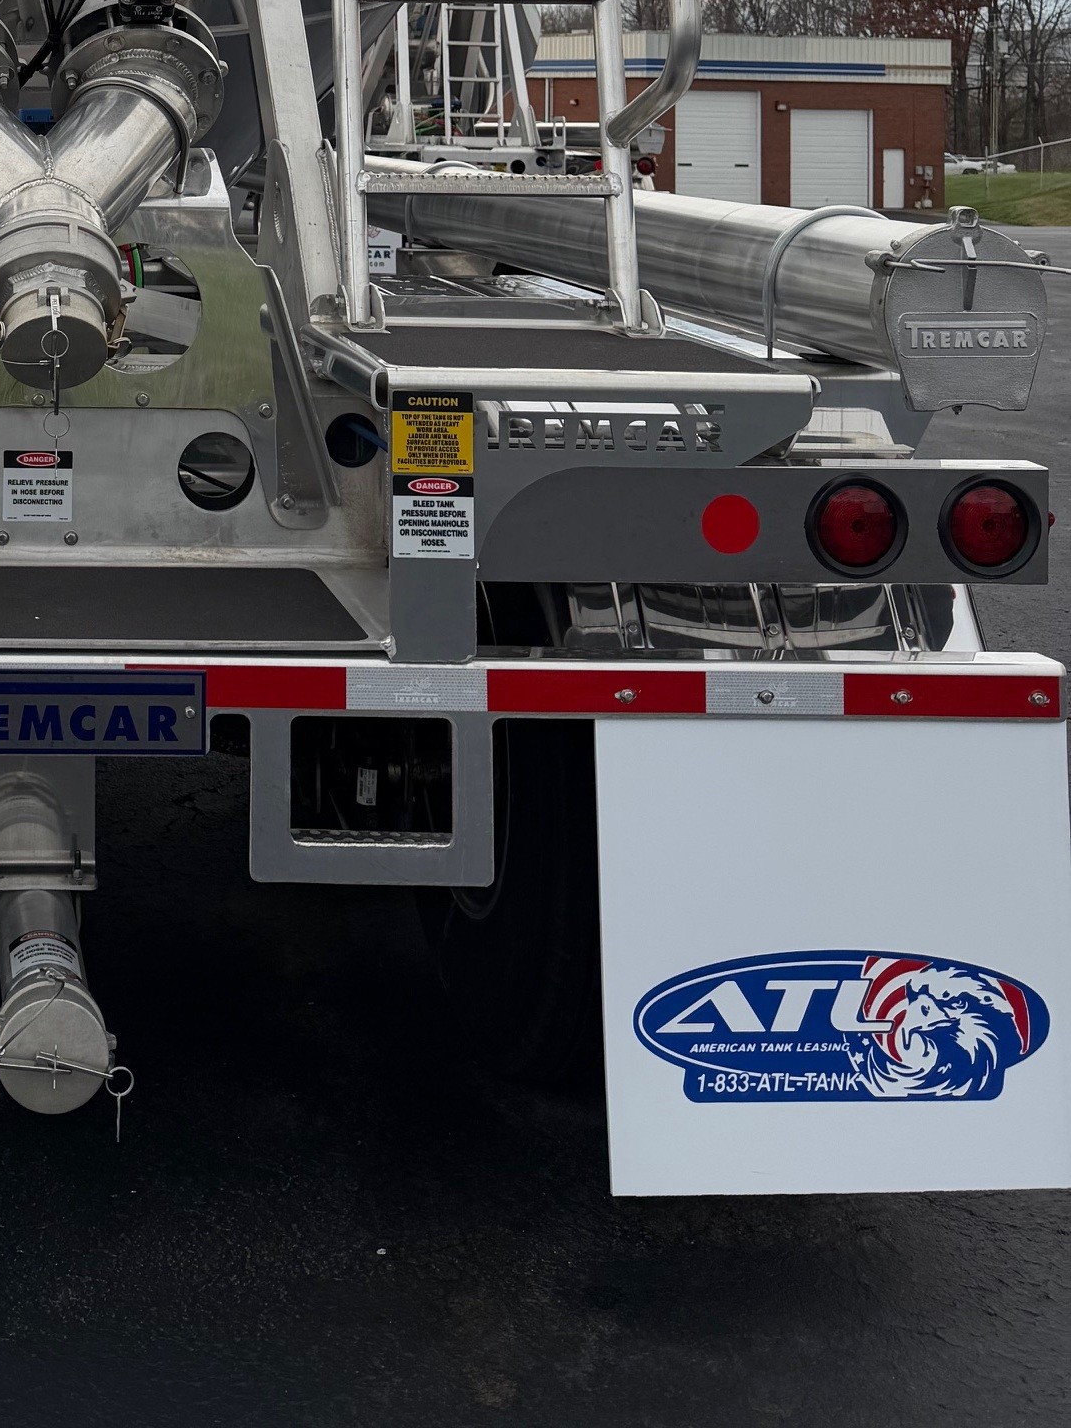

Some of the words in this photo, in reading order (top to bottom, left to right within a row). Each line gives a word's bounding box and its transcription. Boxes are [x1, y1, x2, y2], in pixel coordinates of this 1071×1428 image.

[905, 320, 1028, 349] TREMCAR
[408, 396, 459, 407] CAUTION
[416, 482, 452, 490] DANGER
[413, 500, 435, 508] BLEED
[436, 500, 455, 508] TANK
[401, 510, 438, 518] PRESSURE
[439, 510, 467, 518] BEFORE
[398, 519, 430, 527] OPENING
[430, 520, 470, 528] MANHOLES
[411, 529, 469, 538] DISCONNECTING
[421, 539, 447, 547] HOSES.
[656, 980, 894, 1033] ATL
[690, 1043, 757, 1053] AMERICAN
[760, 1043, 792, 1052] TANK
[796, 1042, 851, 1052] LEASING
[697, 1072, 863, 1093] 1-833-ATL-TANK
